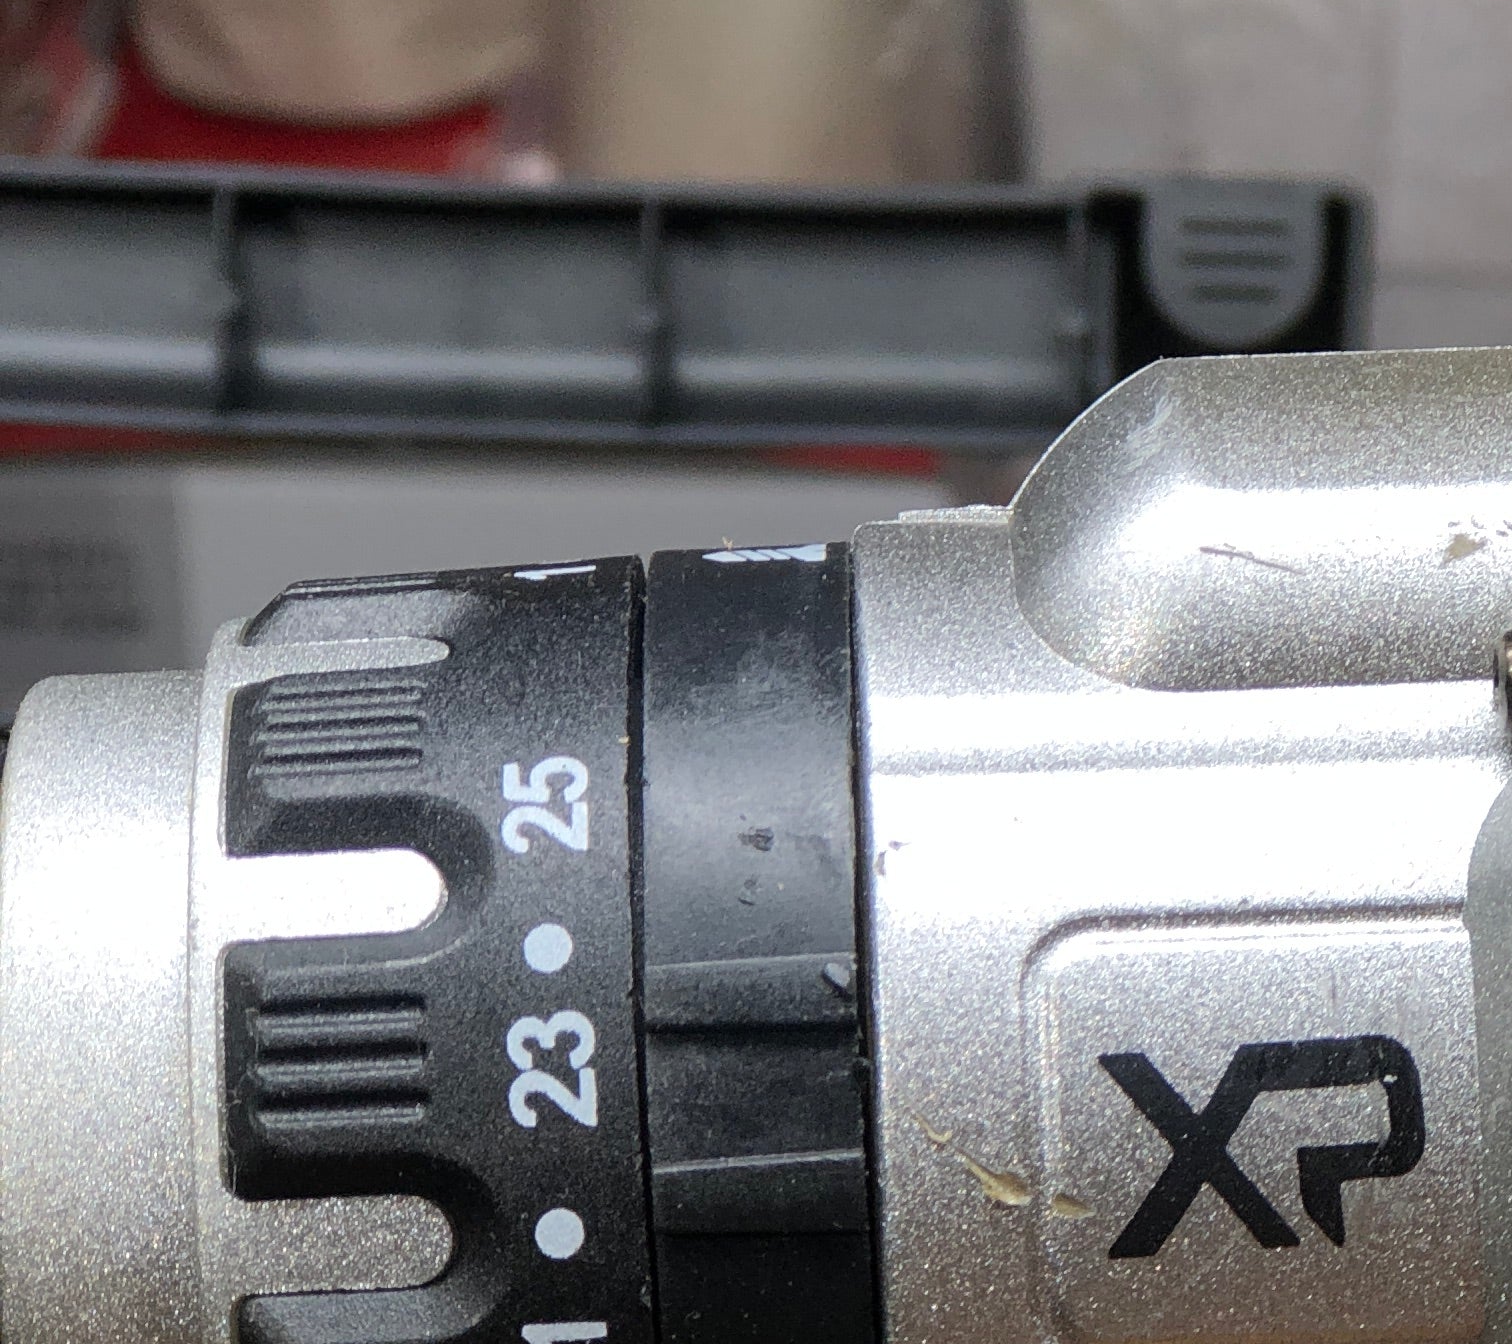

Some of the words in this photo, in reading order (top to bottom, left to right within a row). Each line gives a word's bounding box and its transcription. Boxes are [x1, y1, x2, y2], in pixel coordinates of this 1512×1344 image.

[501, 755, 590, 855] 25
[506, 1009, 599, 1128] 23
[1098, 1033, 1426, 1259] XP
